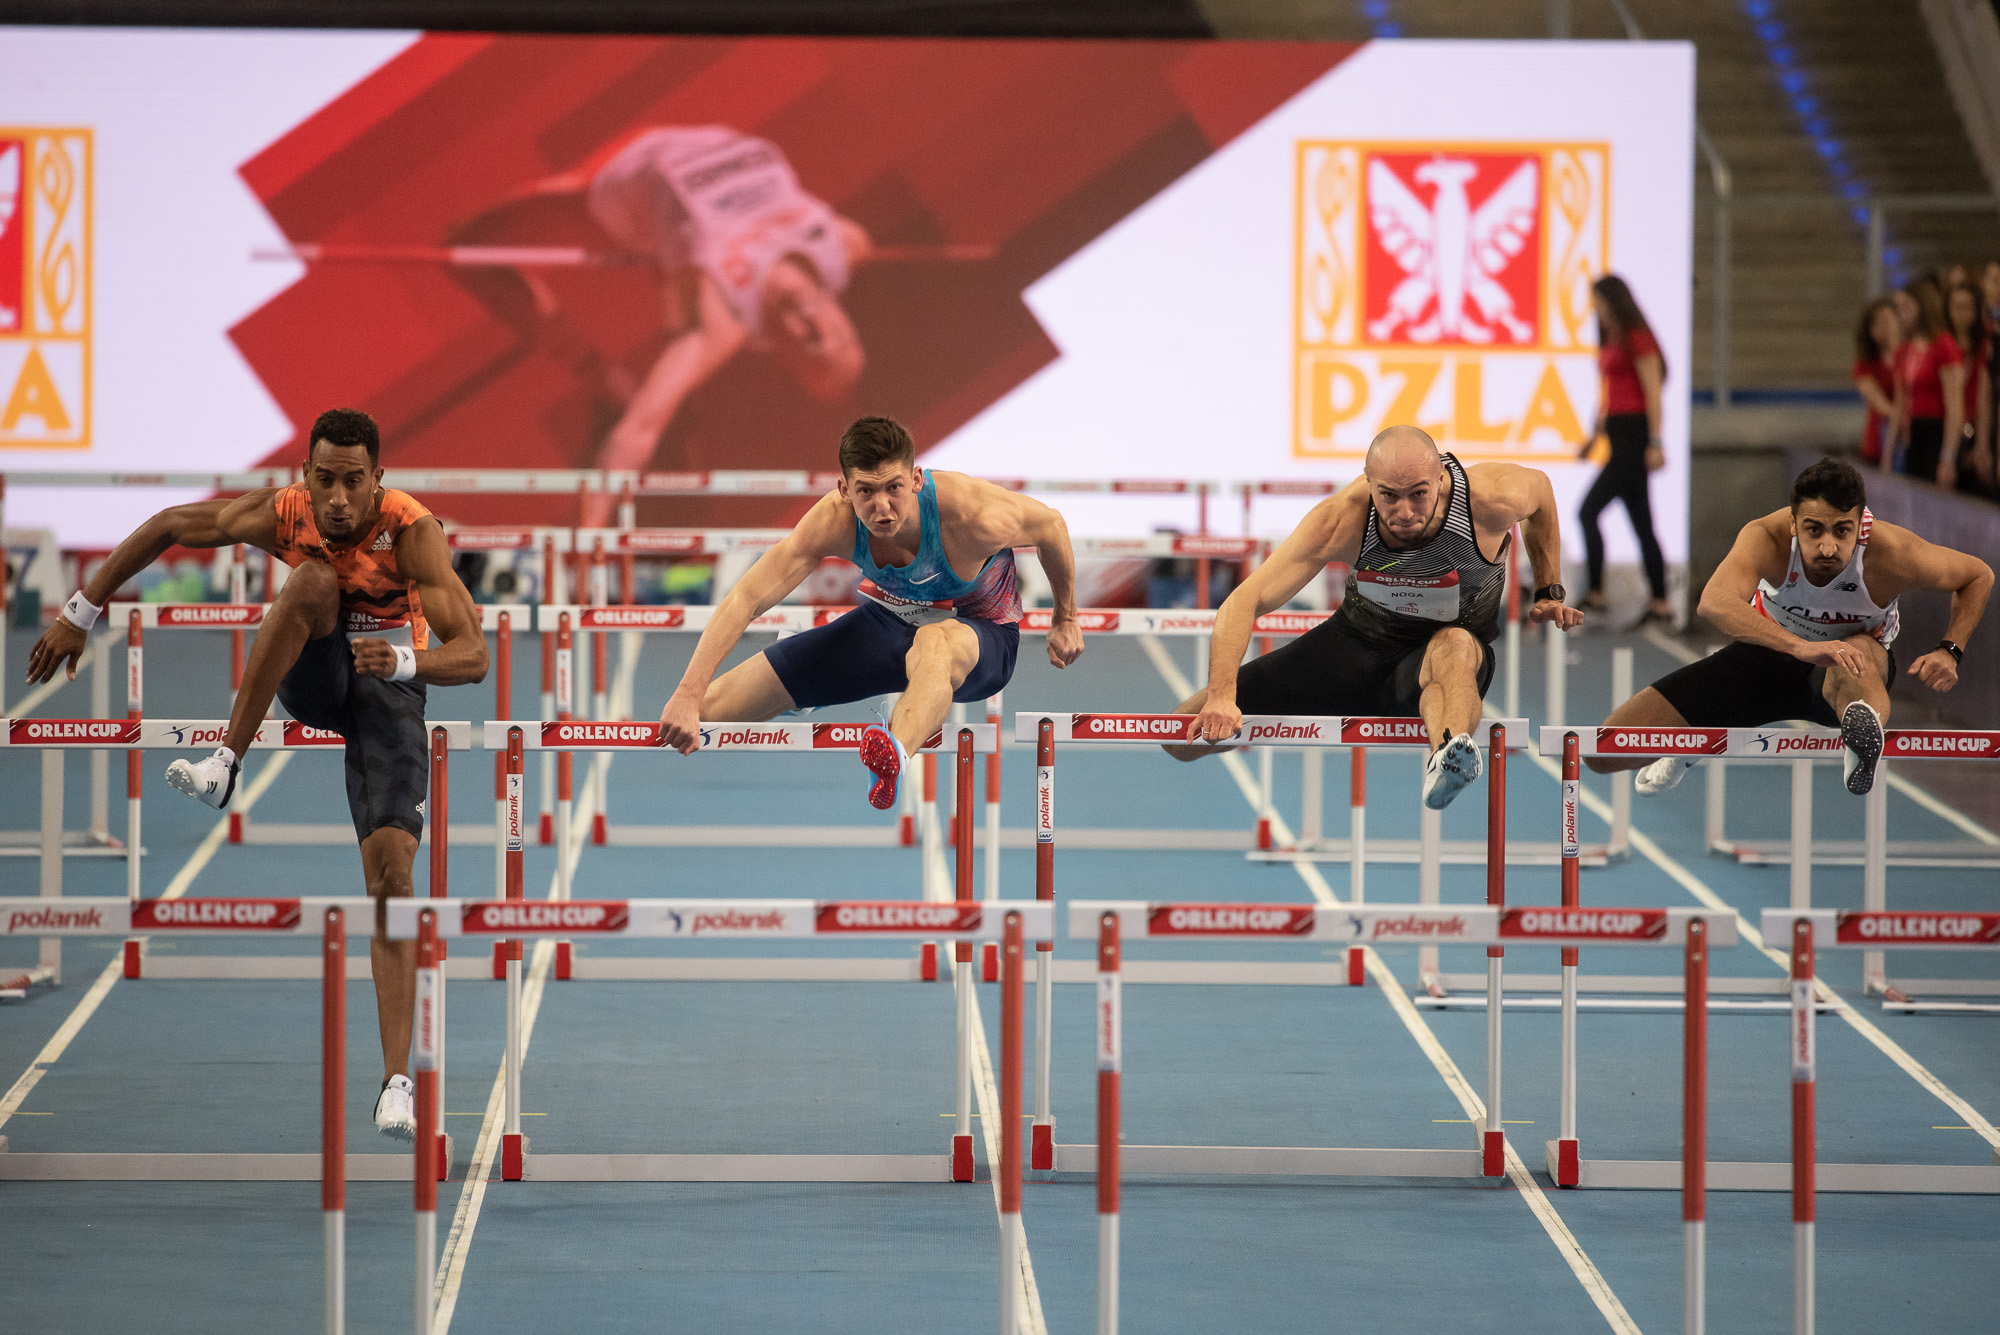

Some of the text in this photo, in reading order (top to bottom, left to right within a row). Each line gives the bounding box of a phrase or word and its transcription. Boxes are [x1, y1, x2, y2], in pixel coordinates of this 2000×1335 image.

[1312, 360, 1588, 444] PZLA
[1375, 576, 1416, 584] ORLEN
[171, 608, 249, 622] ORLEN CUP
[593, 611, 642, 624] ORLEN
[896, 608, 929, 617] YKIER
[1786, 616, 1829, 637] PERERA
[27, 723, 122, 738] ORLEN CUP
[190, 726, 265, 746] polk
[559, 726, 652, 741] ORLEN CUP
[830, 728, 863, 742] ORL
[1089, 719, 1183, 734] ORLEN CUP
[1248, 722, 1321, 742] polanik
[1359, 723, 1419, 738] ORLEN
[717, 728, 791, 748] polanik
[1614, 733, 1708, 748] ORLEN CUP
[1896, 736, 1991, 752] ORLEN CUP
[508, 793, 520, 837] polanik
[1039, 786, 1052, 829] polanik
[1564, 800, 1577, 843] polanik
[8, 907, 102, 933] polanik
[153, 902, 277, 922] ORLEN CUP
[483, 906, 605, 926] ORLEN CUP
[692, 910, 784, 934] polanik
[836, 906, 959, 927] ORLEN CUP
[1169, 908, 1292, 929] ORLEN CUP
[1372, 914, 1466, 940] polanik
[1520, 912, 1643, 934] ORLEN CUP
[1859, 917, 1982, 937] ORLEN CUP
